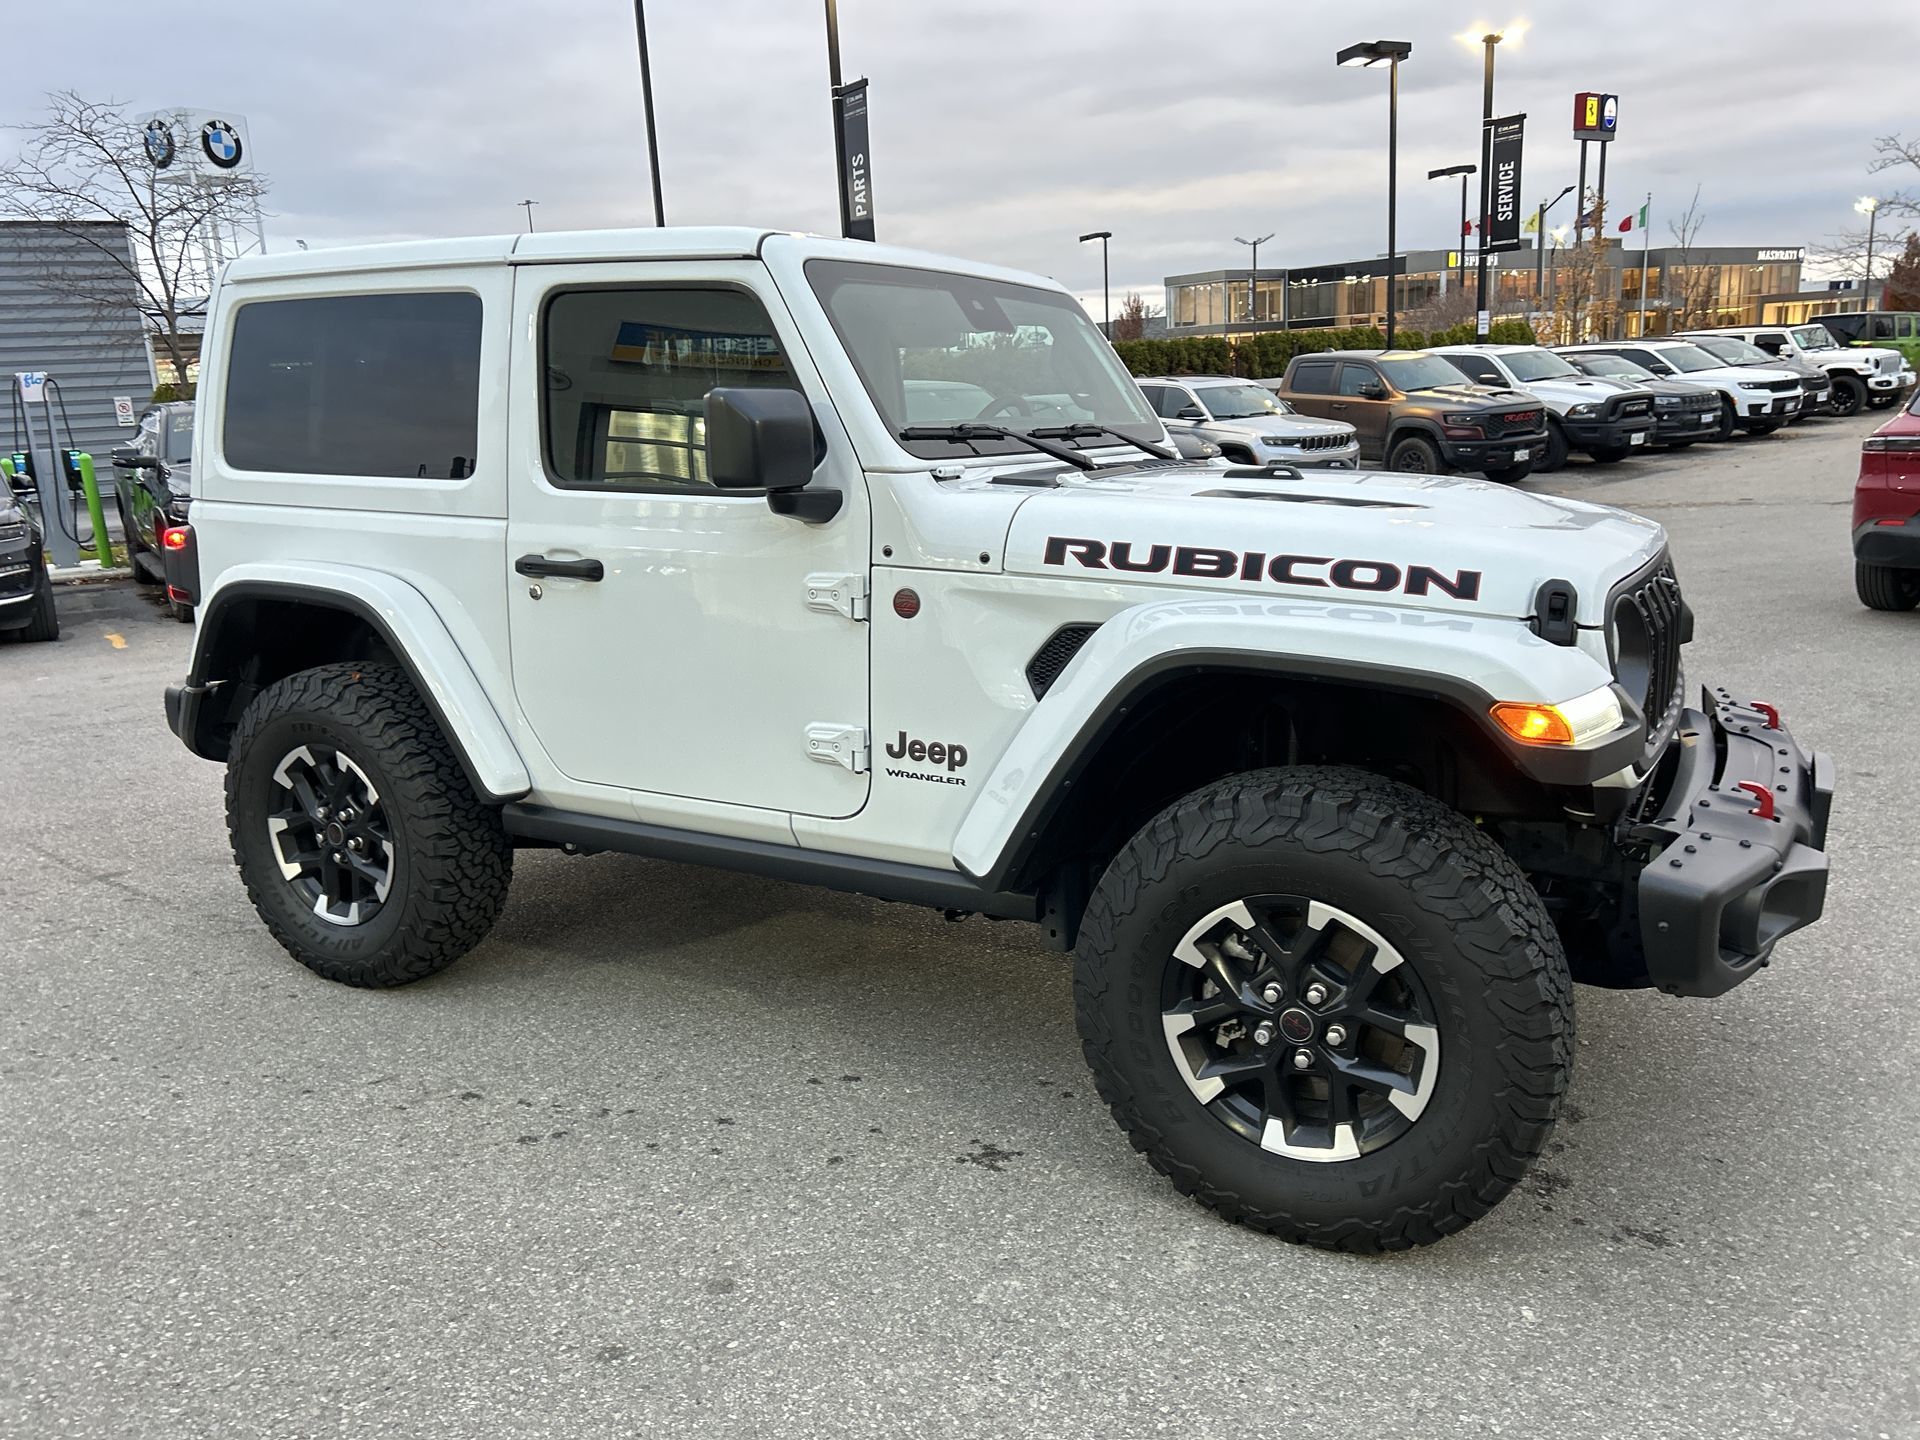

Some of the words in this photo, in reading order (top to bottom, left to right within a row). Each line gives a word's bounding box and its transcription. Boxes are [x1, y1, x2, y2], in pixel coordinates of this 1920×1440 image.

[851, 152, 867, 217] PARTS
[1497, 160, 1515, 222] SERVICE
[23, 372, 44, 388] flo
[1043, 534, 1482, 602] RUBICON
[885, 730, 968, 772] Jeep
[885, 767, 966, 787] WRANGLER
